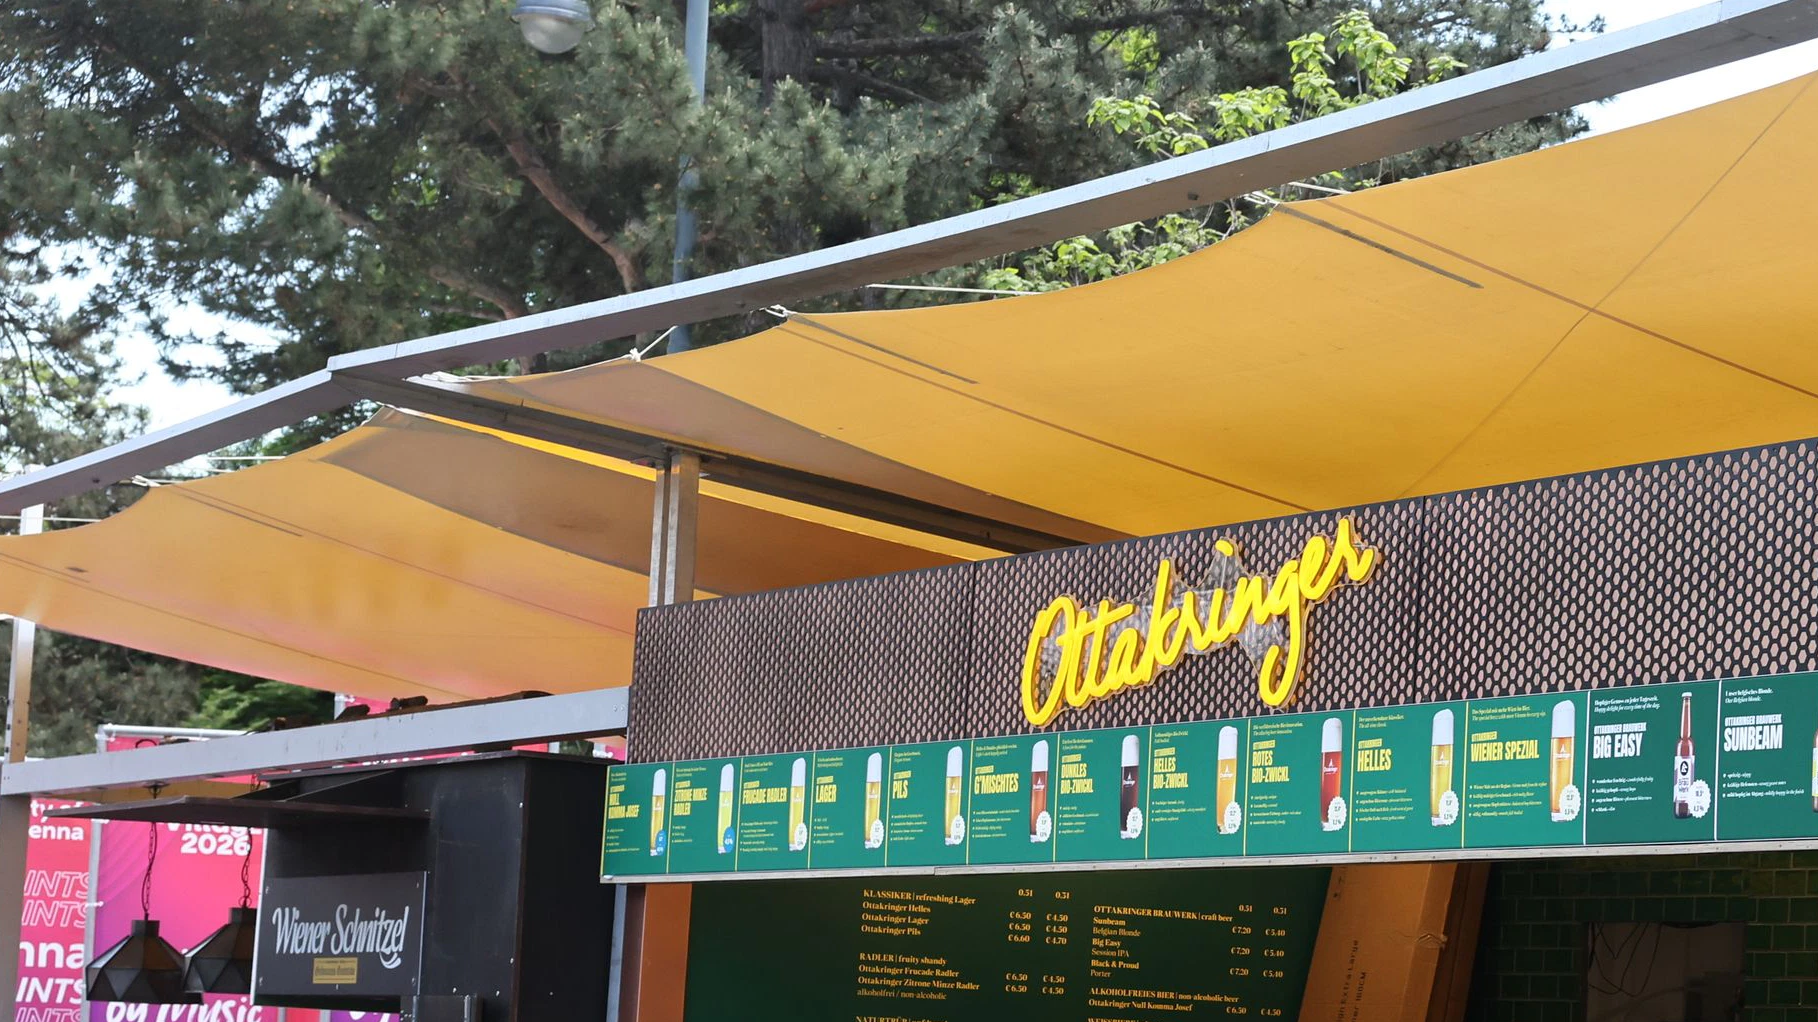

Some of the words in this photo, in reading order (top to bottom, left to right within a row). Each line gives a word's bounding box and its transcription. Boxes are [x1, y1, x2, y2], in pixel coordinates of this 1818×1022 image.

[1021, 517, 1376, 726] Ottakringer
[1593, 735, 1612, 759] BIG
[1614, 732, 1643, 757] EASY
[1723, 724, 1783, 752] SUNBEAM
[1252, 750, 1273, 767] ROTES
[1470, 742, 1503, 762] WIENER
[1505, 739, 1540, 761] SPEZIAL
[1154, 757, 1176, 774] HELLES
[1357, 748, 1392, 772] HELLES
[1061, 763, 1087, 780] DUNKLES
[1252, 766, 1289, 784] BIO-ZWICKL
[893, 781, 908, 799] PILS
[974, 772, 1019, 795] G'MISCHTES
[1060, 778, 1094, 795] BIO-ZWICKL
[1153, 773, 1188, 790] BIO-ZWICKL
[816, 784, 837, 804] LAGER
[181, 832, 250, 857] 2026
[863, 889, 912, 900] KLASSIKER
[955, 895, 977, 905] Lager
[862, 901, 908, 913] Ottakringer
[909, 904, 931, 914] Helles
[1094, 905, 1152, 916] OTTAKRINGER
[1153, 909, 1197, 920] BRAUWERK
[1201, 913, 1218, 921] craft
[1218, 914, 1233, 922] beer
[861, 912, 907, 925] Ottakringer
[908, 916, 930, 926] Lager
[1093, 917, 1126, 926] Sunbeam
[272, 906, 332, 954] Wiener
[331, 904, 410, 968] Schnitzel
[860, 924, 906, 936] Ottakringer
[907, 927, 922, 936] Pils
[1093, 927, 1117, 936] Belgian
[1118, 929, 1141, 937] Blonde
[1092, 938, 1104, 947] Big
[1105, 940, 1121, 948] Easy
[860, 952, 895, 963] RADLER
[898, 955, 920, 966] fruity
[921, 957, 948, 967] shandy
[1091, 949, 1117, 957] Session
[1118, 950, 1129, 958] IPA
[858, 964, 904, 976] Ottakringer
[935, 970, 960, 979] Radler
[1091, 959, 1110, 968] Black
[1118, 961, 1139, 969] Proud
[858, 976, 903, 988] Ottakringer
[1090, 970, 1111, 978] Porter
[1090, 988, 1156, 998] ALKOHOLFREIES
[1157, 991, 1174, 999] BIER
[1088, 999, 1130, 1009] Ottakringer
[1131, 1001, 1146, 1009] Null
[1148, 1002, 1174, 1010] Komma
[1174, 1003, 1193, 1012] Josef
